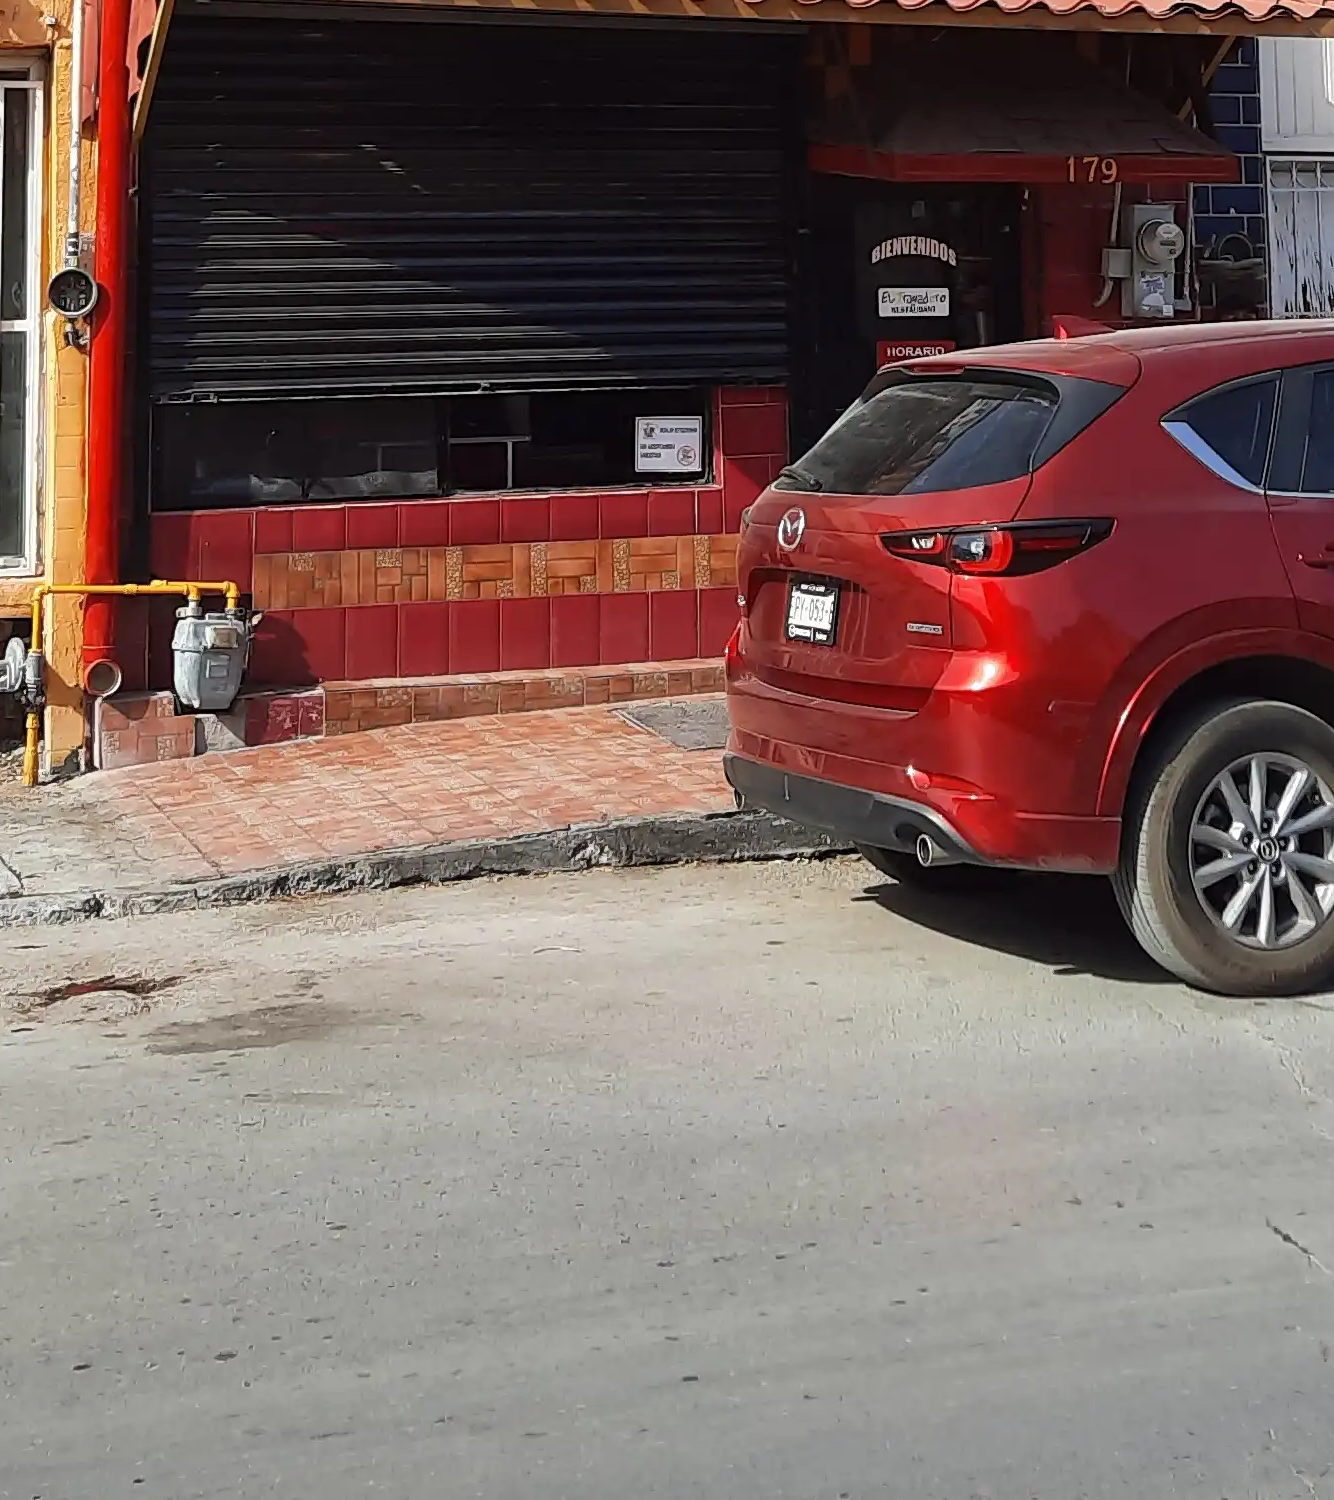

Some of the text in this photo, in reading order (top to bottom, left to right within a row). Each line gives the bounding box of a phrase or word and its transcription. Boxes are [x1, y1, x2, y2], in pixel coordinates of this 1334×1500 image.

[1067, 155, 1118, 184] 179
[870, 235, 958, 267] BIENVENIDOS
[886, 346, 945, 357] HORARIO
